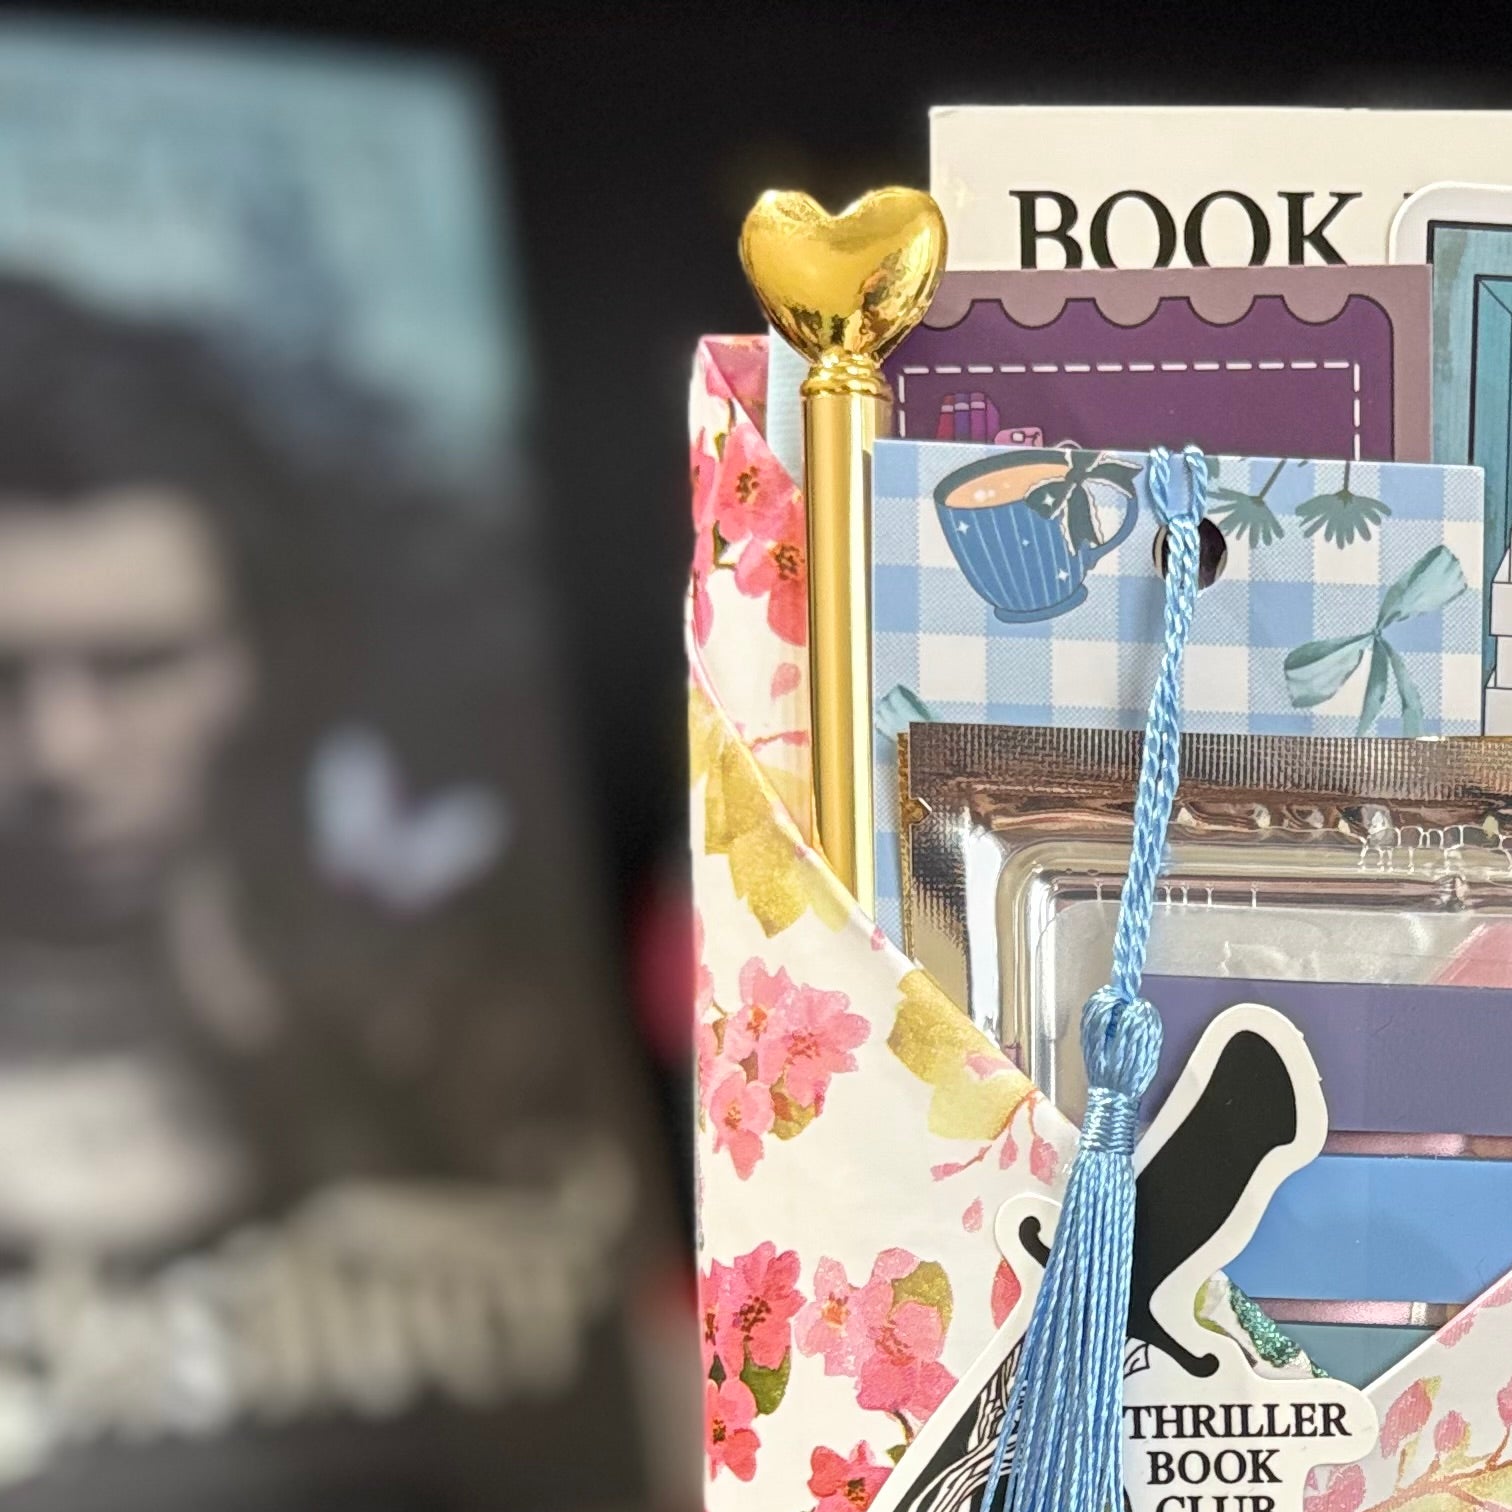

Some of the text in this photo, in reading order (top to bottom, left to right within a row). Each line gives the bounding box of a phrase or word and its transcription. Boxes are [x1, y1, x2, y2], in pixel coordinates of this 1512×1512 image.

[1008, 189, 1362, 270] BOOK
[1122, 1402, 1353, 1440] THRILLER
[1146, 1449, 1283, 1486] BOOK
